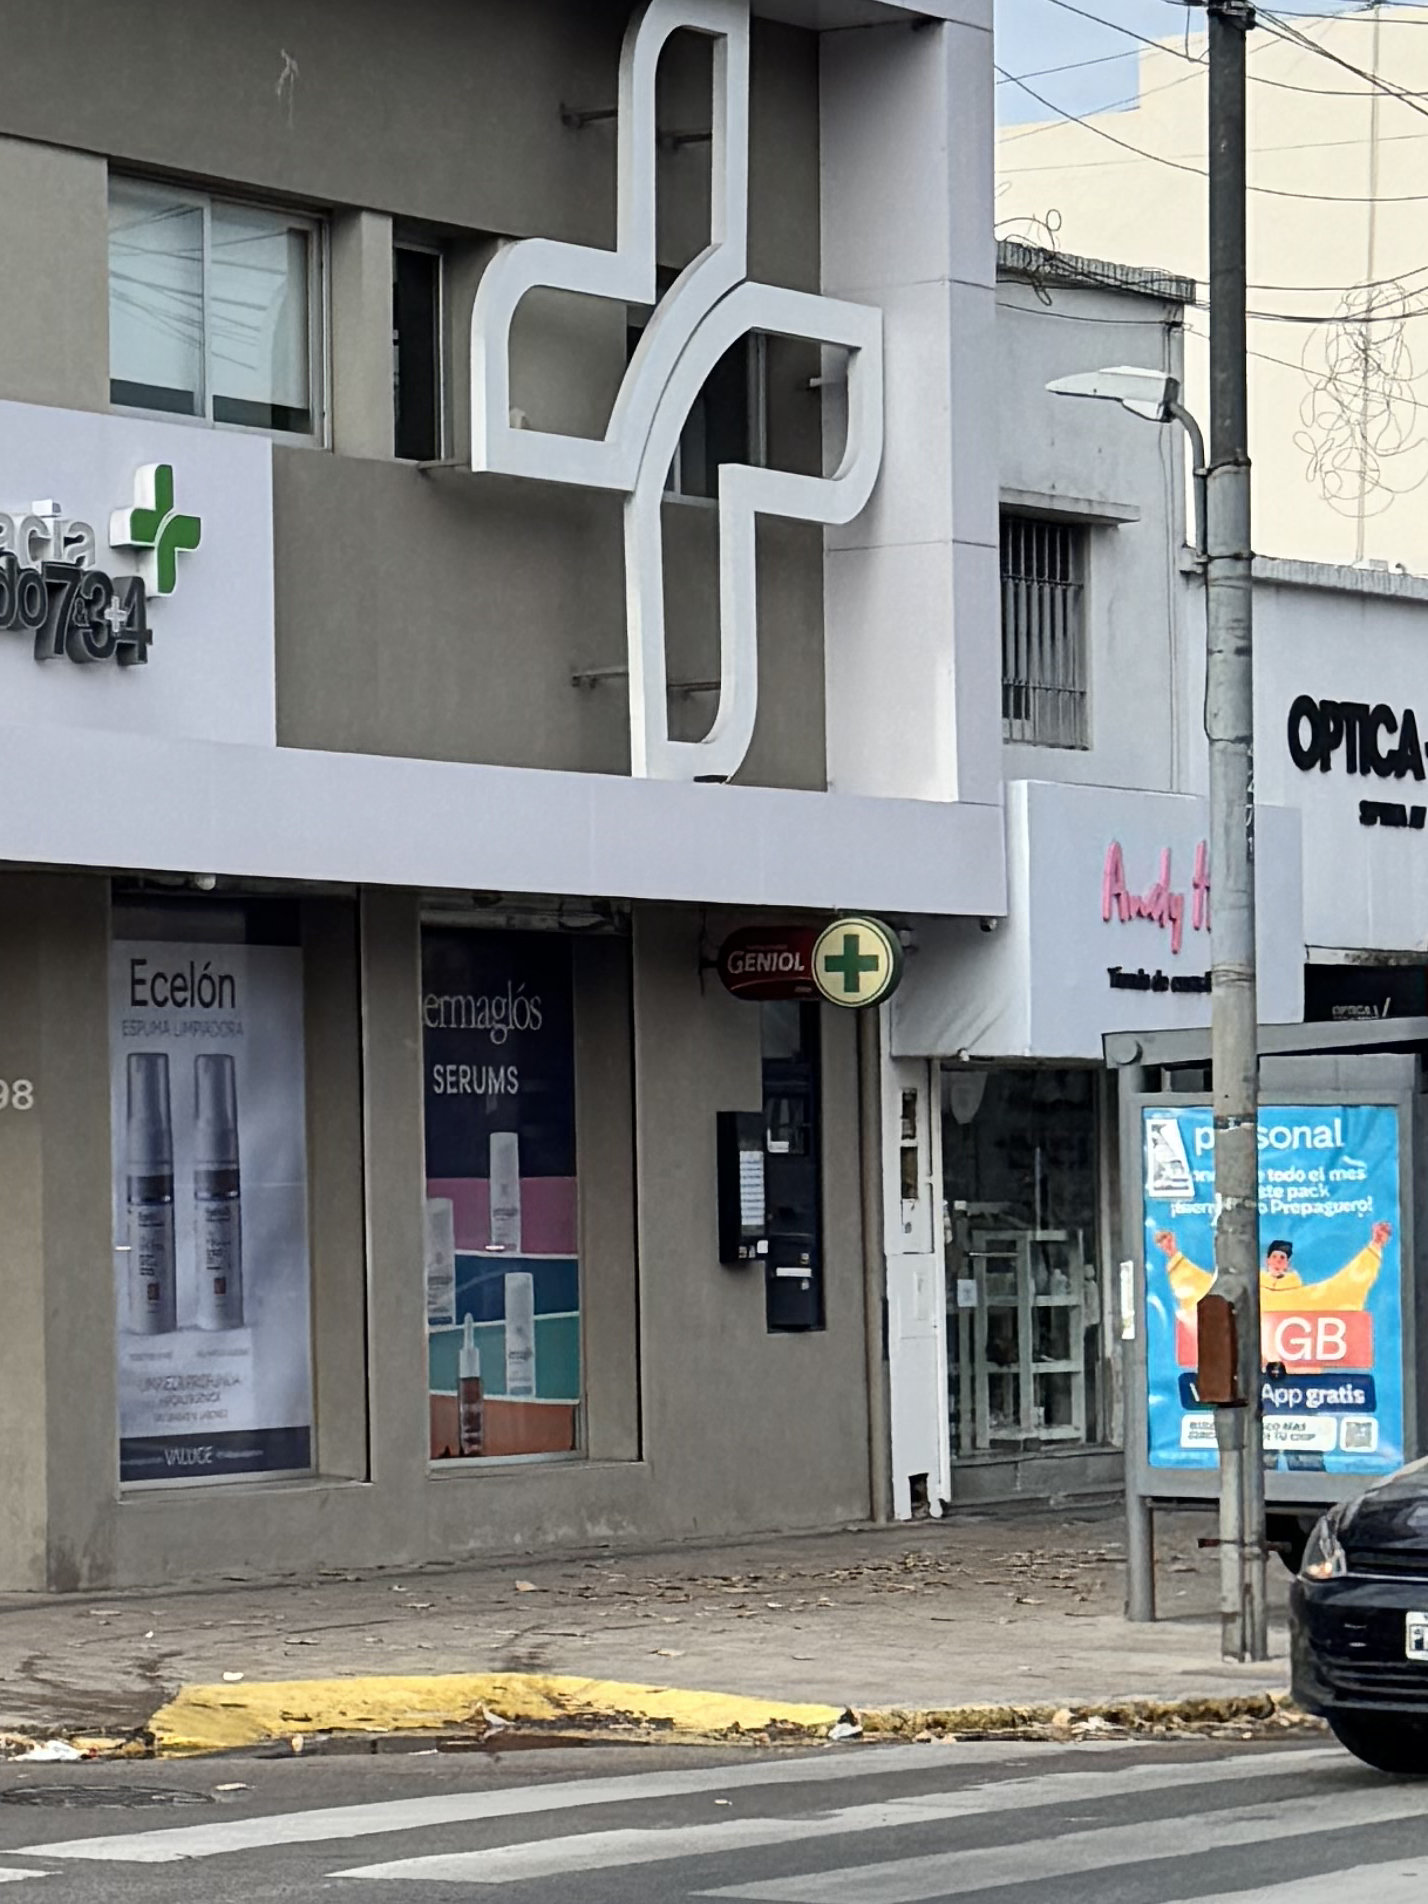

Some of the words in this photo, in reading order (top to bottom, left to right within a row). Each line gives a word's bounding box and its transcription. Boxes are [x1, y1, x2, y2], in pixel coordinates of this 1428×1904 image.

[1287, 694, 1426, 781] OPTICA
[727, 951, 805, 974] GENIOL
[130, 958, 236, 1009] Ecelón
[423, 980, 543, 1045] ermaglós
[433, 1064, 519, 1095] SERUMS
[1196, 1117, 1345, 1156] psonal
[1267, 1169, 1305, 1182] todo
[1308, 1167, 1325, 1182] el
[1329, 1169, 1367, 1182] mes
[1287, 1183, 1330, 1201] pack
[1305, 1383, 1366, 1408] gratis
